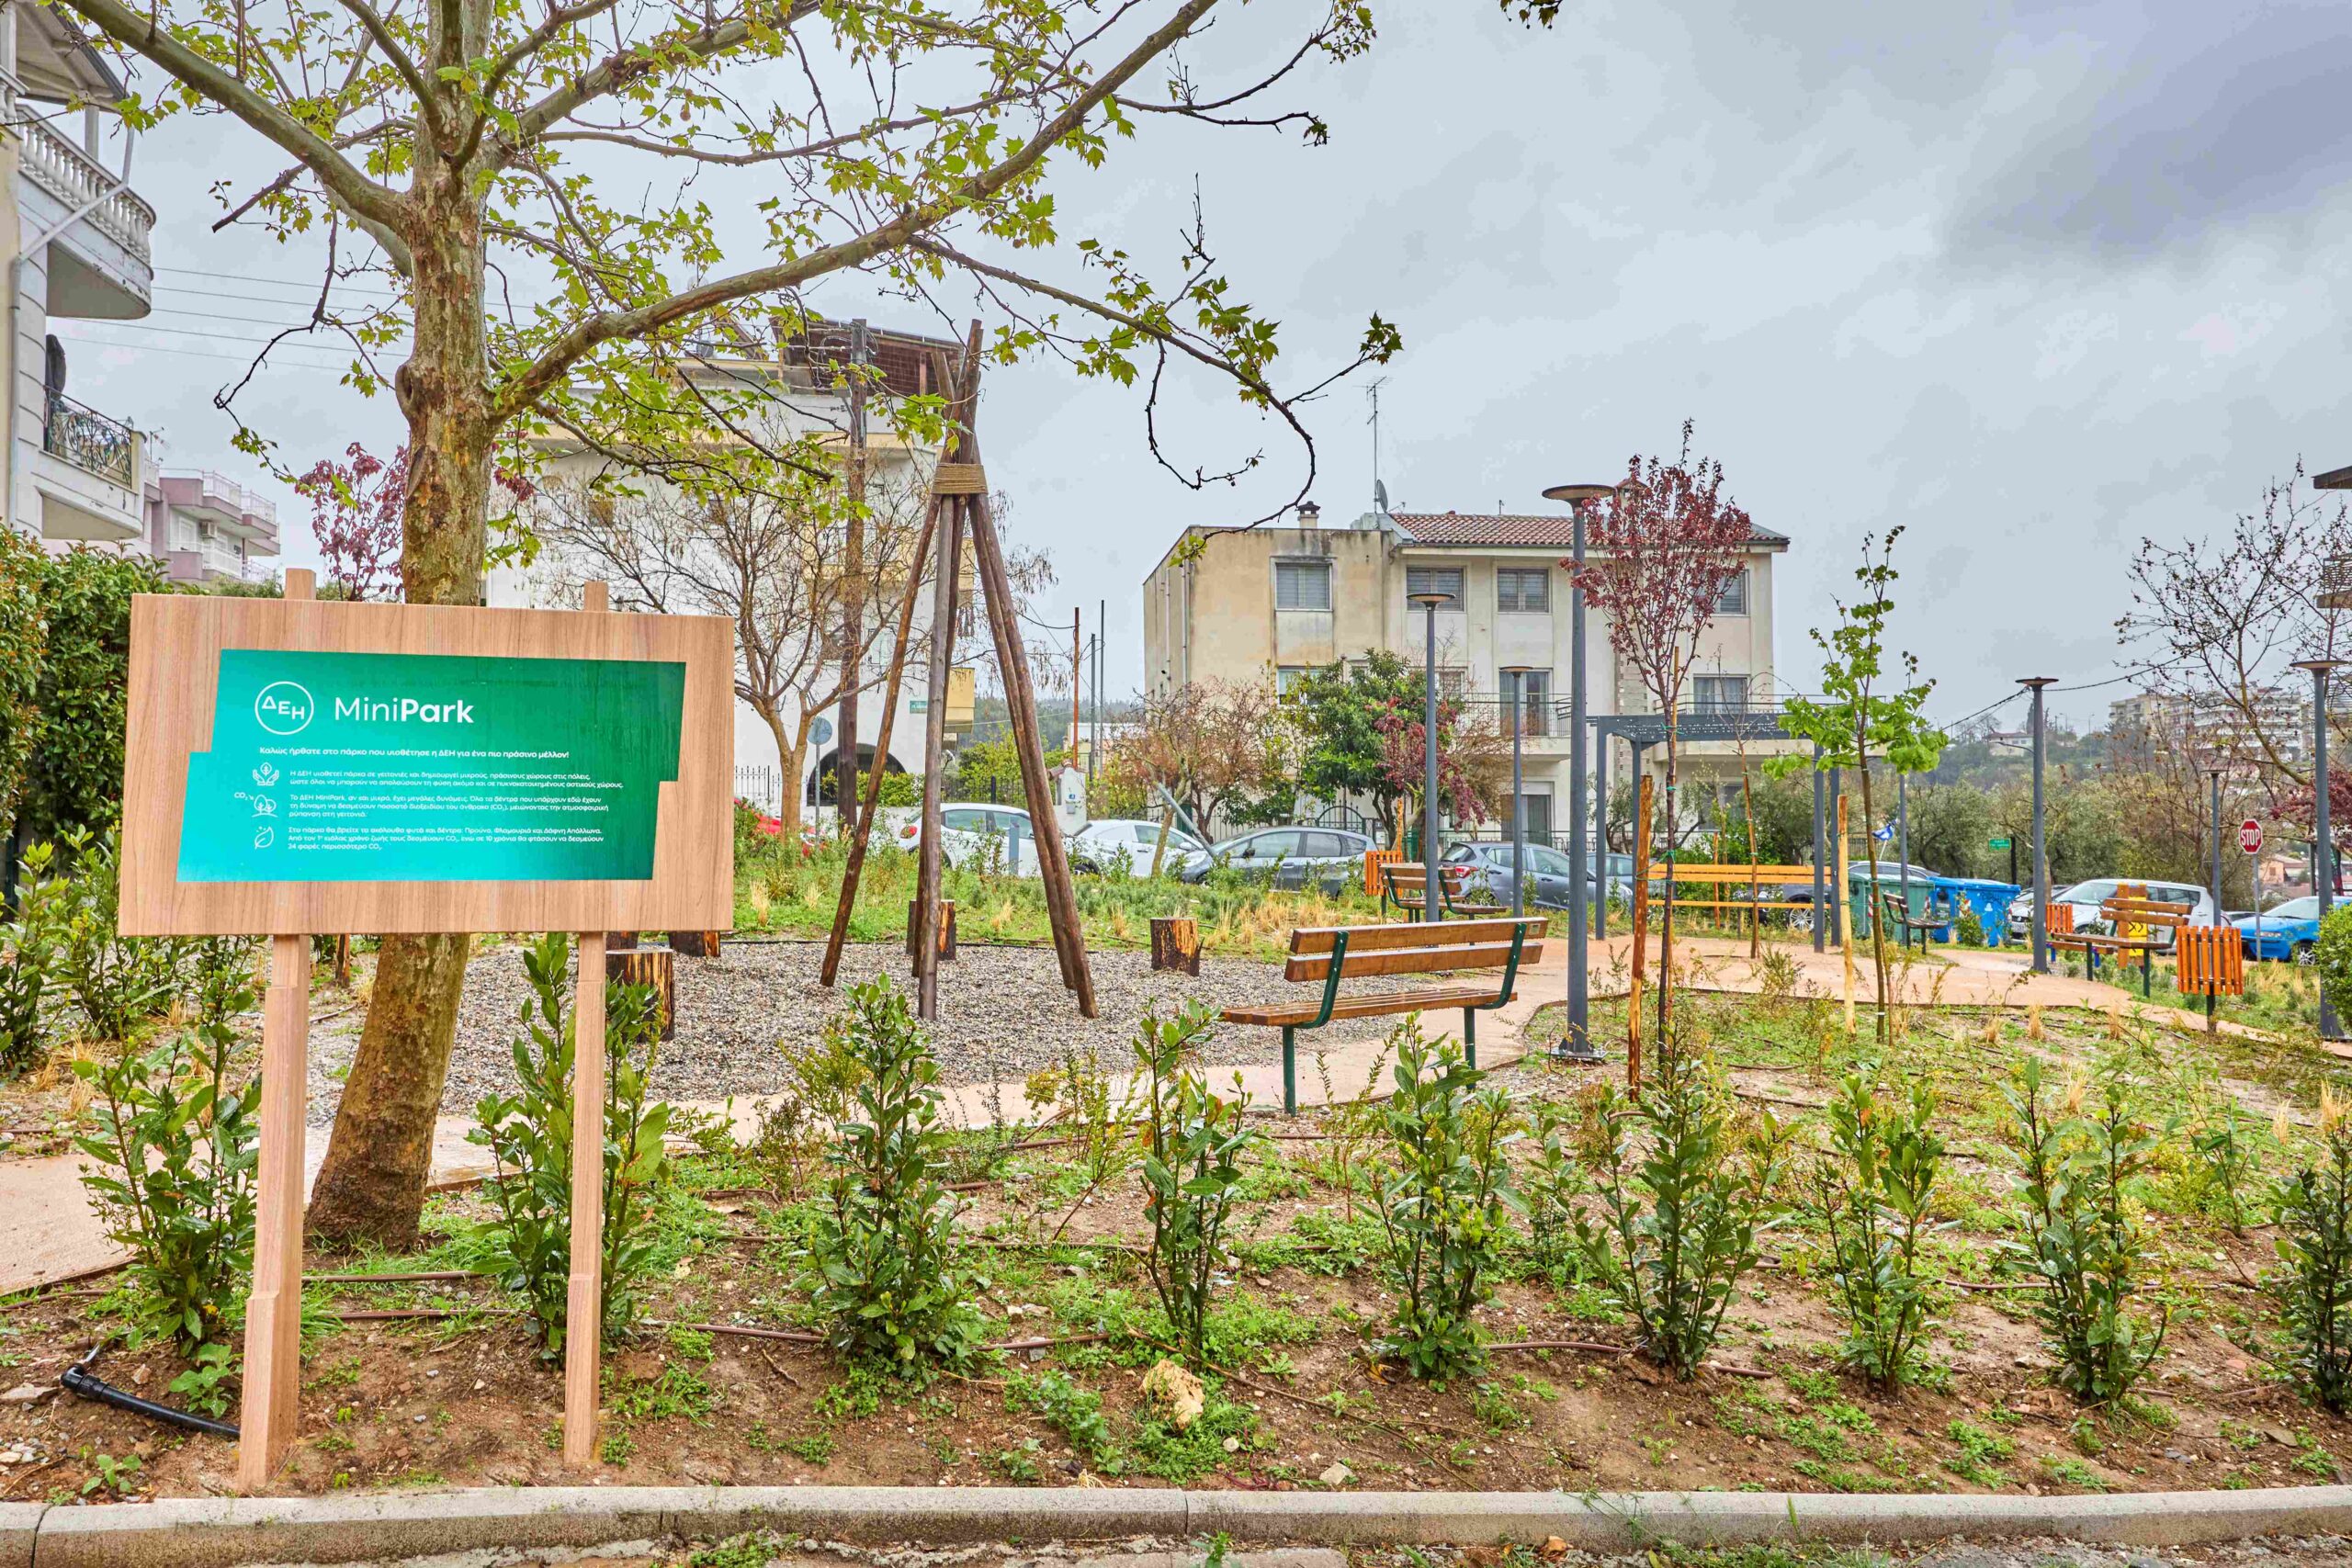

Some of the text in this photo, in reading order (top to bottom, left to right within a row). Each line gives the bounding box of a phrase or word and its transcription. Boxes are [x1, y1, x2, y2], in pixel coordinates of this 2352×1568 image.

[262, 695, 305, 720] ΔΕΗ
[336, 696, 472, 724] MiniPark
[260, 746, 287, 755] Καλώς
[289, 747, 320, 756] ήρθατε
[340, 748, 367, 757] πάρκο
[387, 749, 429, 757] υιοθέτησε
[432, 750, 436, 758] η
[439, 749, 455, 757] ΔΕΗ
[457, 750, 469, 759] για
[472, 750, 486, 758] ένα
[503, 750, 537, 759] πράσινο
[538, 750, 569, 759] μέλλον!
[2240, 829, 2260, 846] STOP
